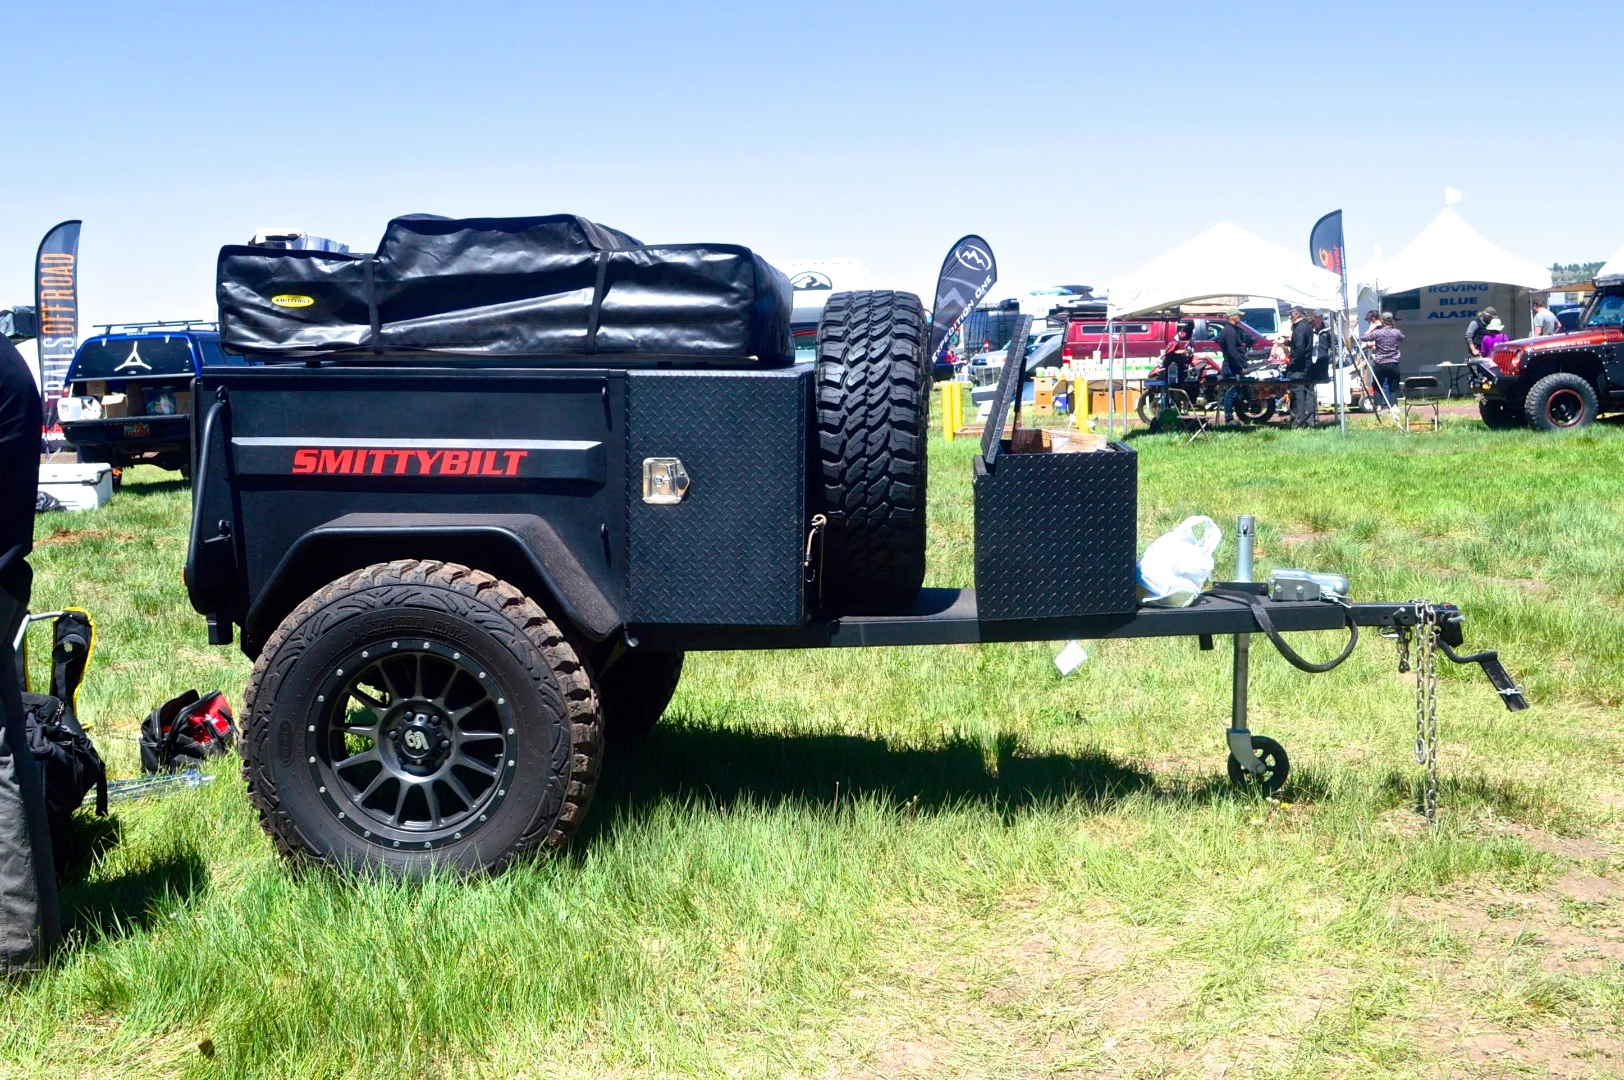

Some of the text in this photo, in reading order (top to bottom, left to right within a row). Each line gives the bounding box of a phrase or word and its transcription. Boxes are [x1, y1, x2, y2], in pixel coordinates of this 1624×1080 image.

[1428, 283, 1489, 293] ROVING
[1439, 297, 1478, 306] BLUE
[932, 274, 992, 364] EXPEDITION ONE
[1428, 310, 1477, 320] ALASK
[43, 337, 75, 402] TRAILS
[292, 449, 528, 476] SMITTYBILT
